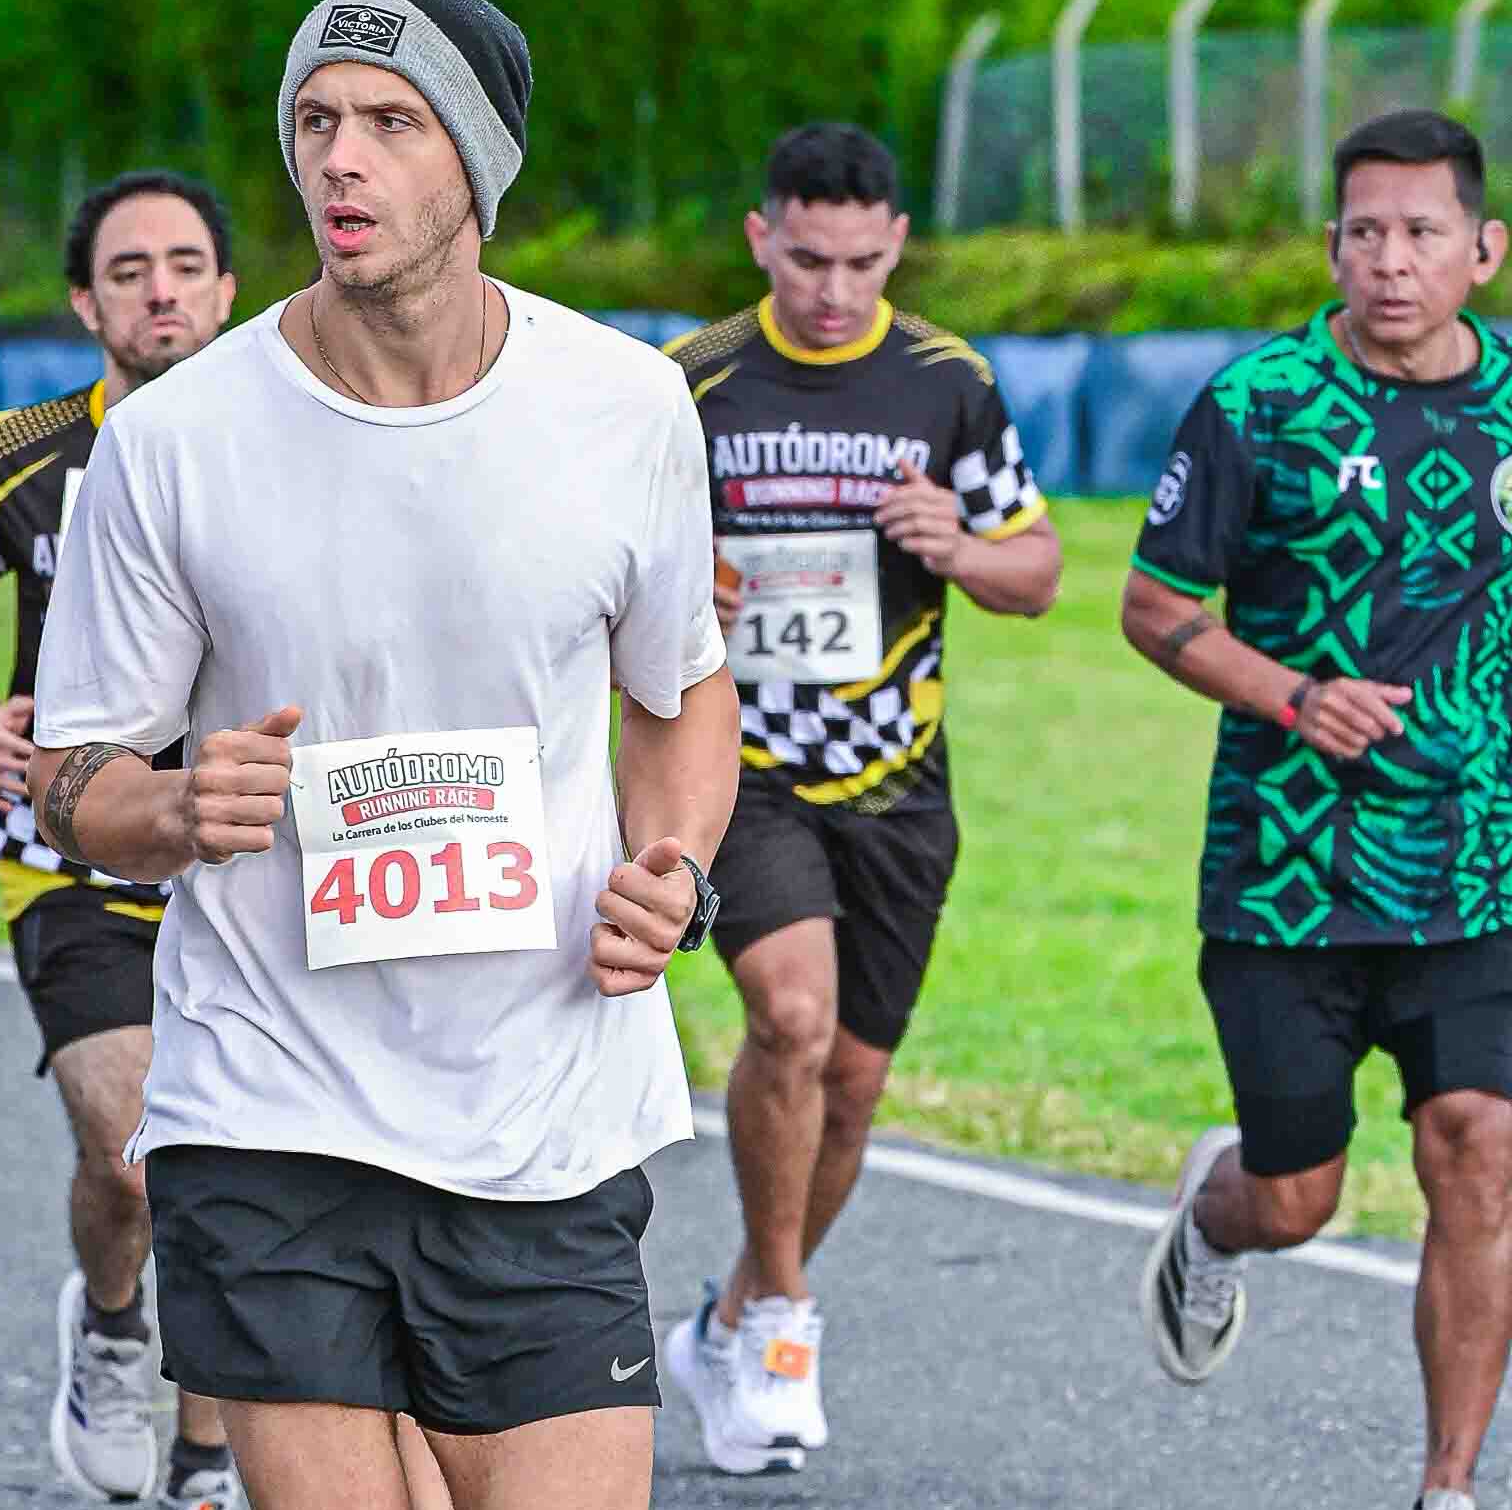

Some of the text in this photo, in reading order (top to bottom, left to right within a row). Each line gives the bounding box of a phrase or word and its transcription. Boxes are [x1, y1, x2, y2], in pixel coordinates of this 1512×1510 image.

[338, 20, 387, 35] VICTORIA
[712, 422, 931, 479] AUTÓDROMO
[745, 609, 852, 657] 142
[327, 747, 505, 805] AUTÓDROMO
[332, 813, 509, 842] La Carrera de los Clubes del Noroeste
[358, 789, 479, 820] RUNNING RACE
[310, 841, 538, 925] 4013
